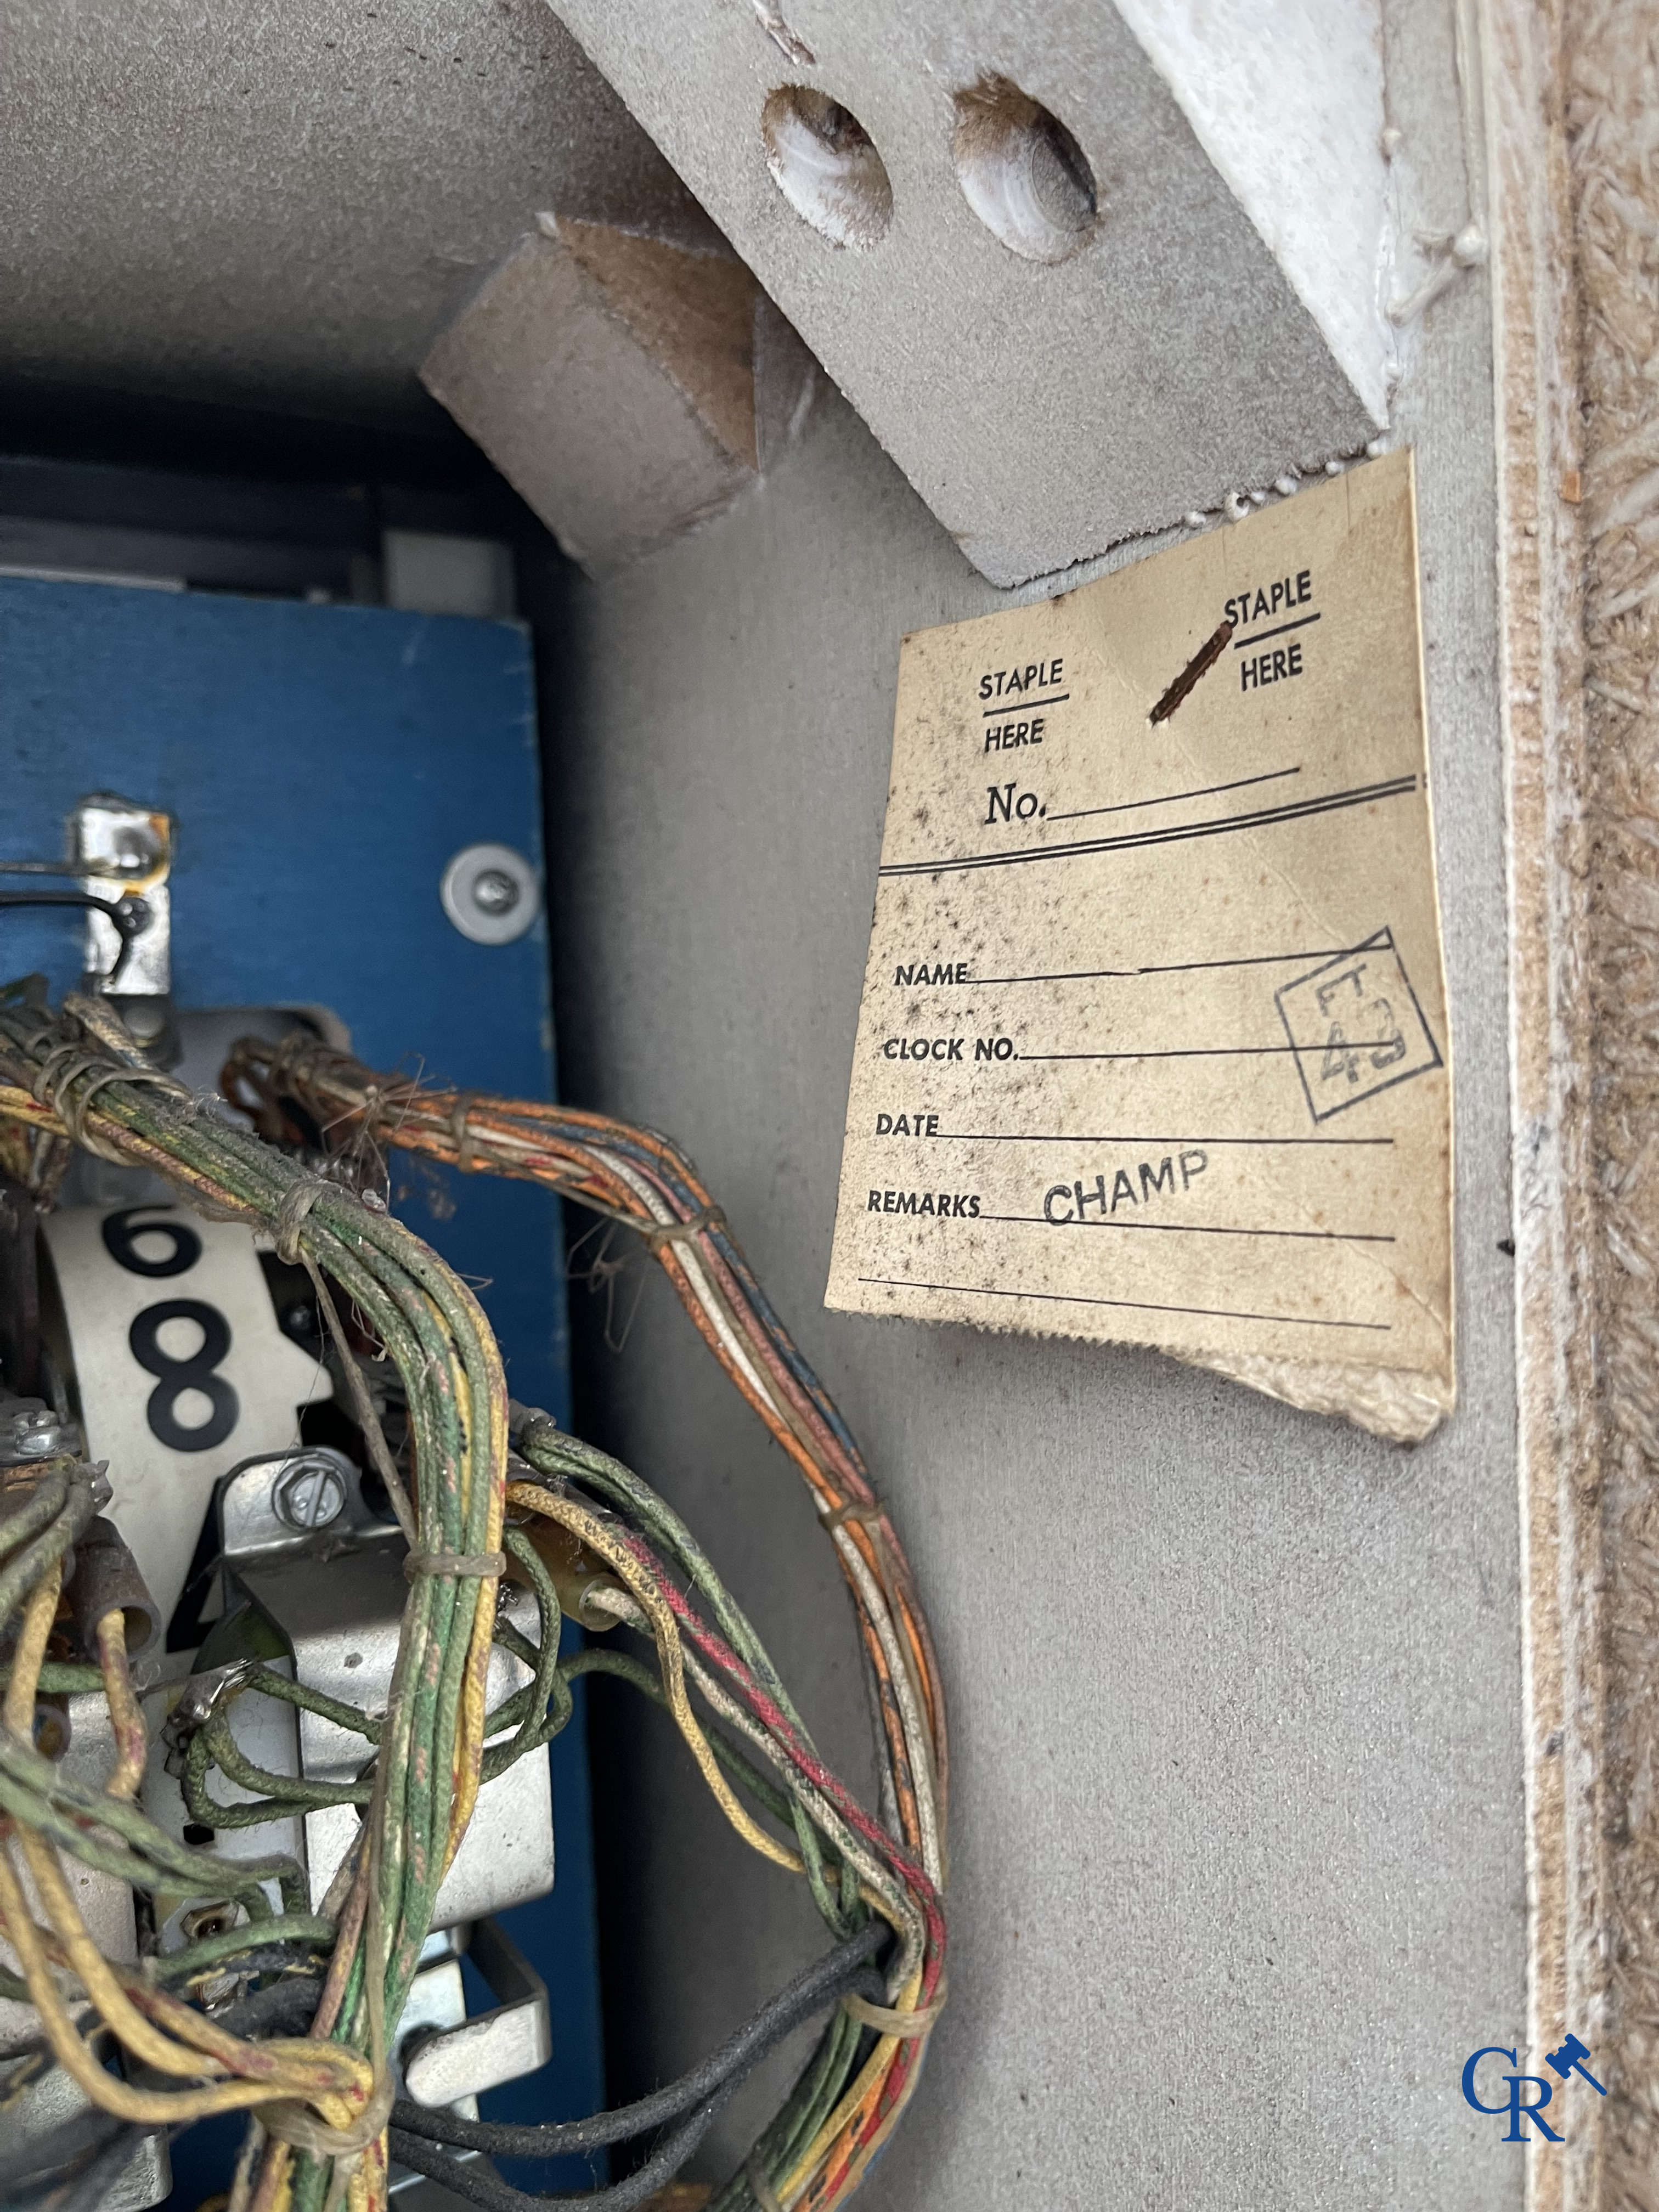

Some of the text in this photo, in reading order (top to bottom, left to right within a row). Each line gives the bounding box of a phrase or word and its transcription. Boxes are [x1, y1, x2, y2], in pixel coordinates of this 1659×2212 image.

[1223, 568, 1312, 629] STAPLE
[978, 658, 1064, 701] STAPLE
[1240, 643, 1304, 692] HERE
[984, 718, 1045, 754] HERE
[985, 782, 1047, 825] No.
[894, 962, 969, 988] NAME
[882, 1037, 1020, 1062] CLOCK NO.
[876, 1113, 940, 1138] DATE
[867, 1189, 982, 1220] REMARKS
[1043, 1148, 1210, 1227] CHAMP
[129, 1299, 240, 1453] 8
